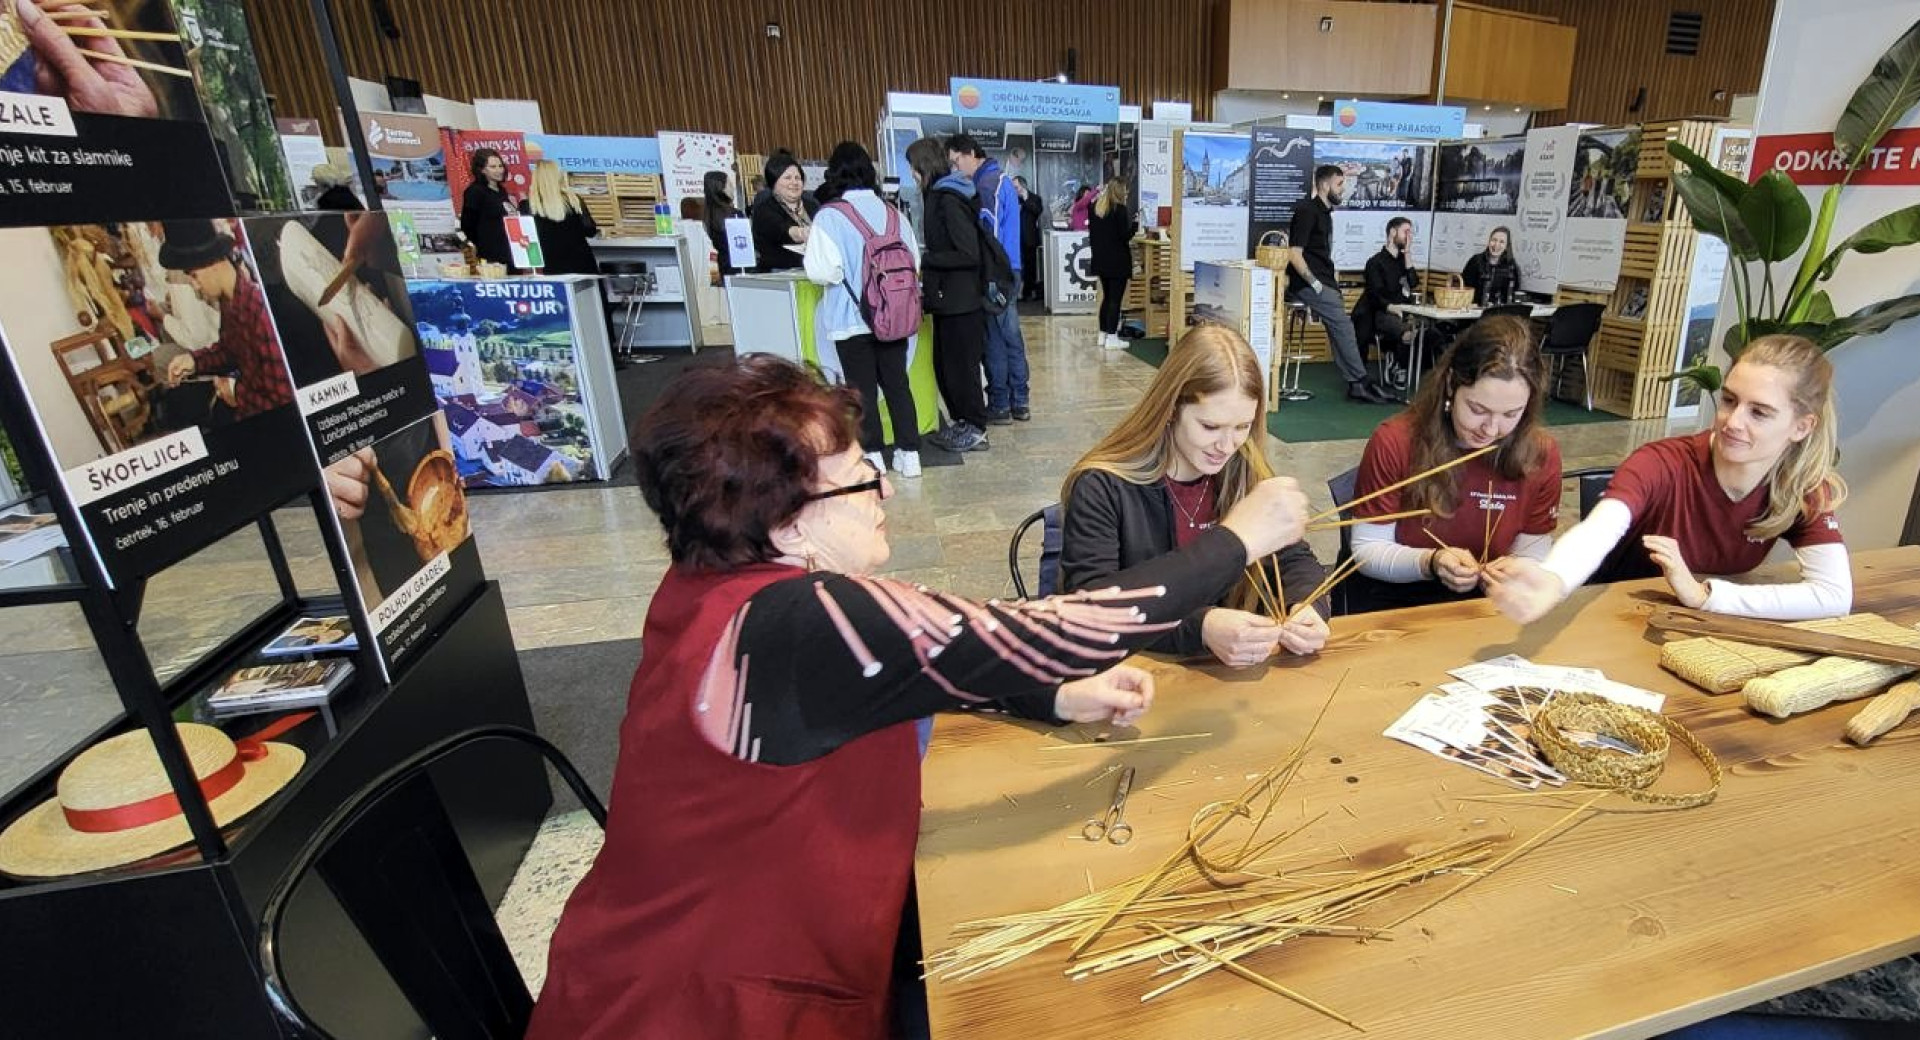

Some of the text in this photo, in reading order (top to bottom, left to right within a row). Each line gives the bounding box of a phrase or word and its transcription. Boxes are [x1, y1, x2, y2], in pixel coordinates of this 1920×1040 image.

[1032, 95, 1080, 106] TRBOVLJE
[1365, 122, 1441, 134] TERME PARADISO
[25, 146, 50, 164] kit
[51, 151, 70, 164] za
[73, 149, 133, 167] slamnike
[558, 157, 598, 168] TERME
[604, 159, 659, 169] BANOVCI
[1774, 147, 1904, 170] ODKRTE
[28, 179, 73, 194] februar
[505, 301, 557, 314] TOUR
[309, 381, 349, 406] KAMNIK
[87, 441, 191, 491] ŠKOFLJICA
[102, 458, 239, 525] Trenje in predenje lanu
[171, 501, 204, 522] februar
[378, 589, 413, 624] POLHOV
[414, 560, 444, 592] GRADEC
